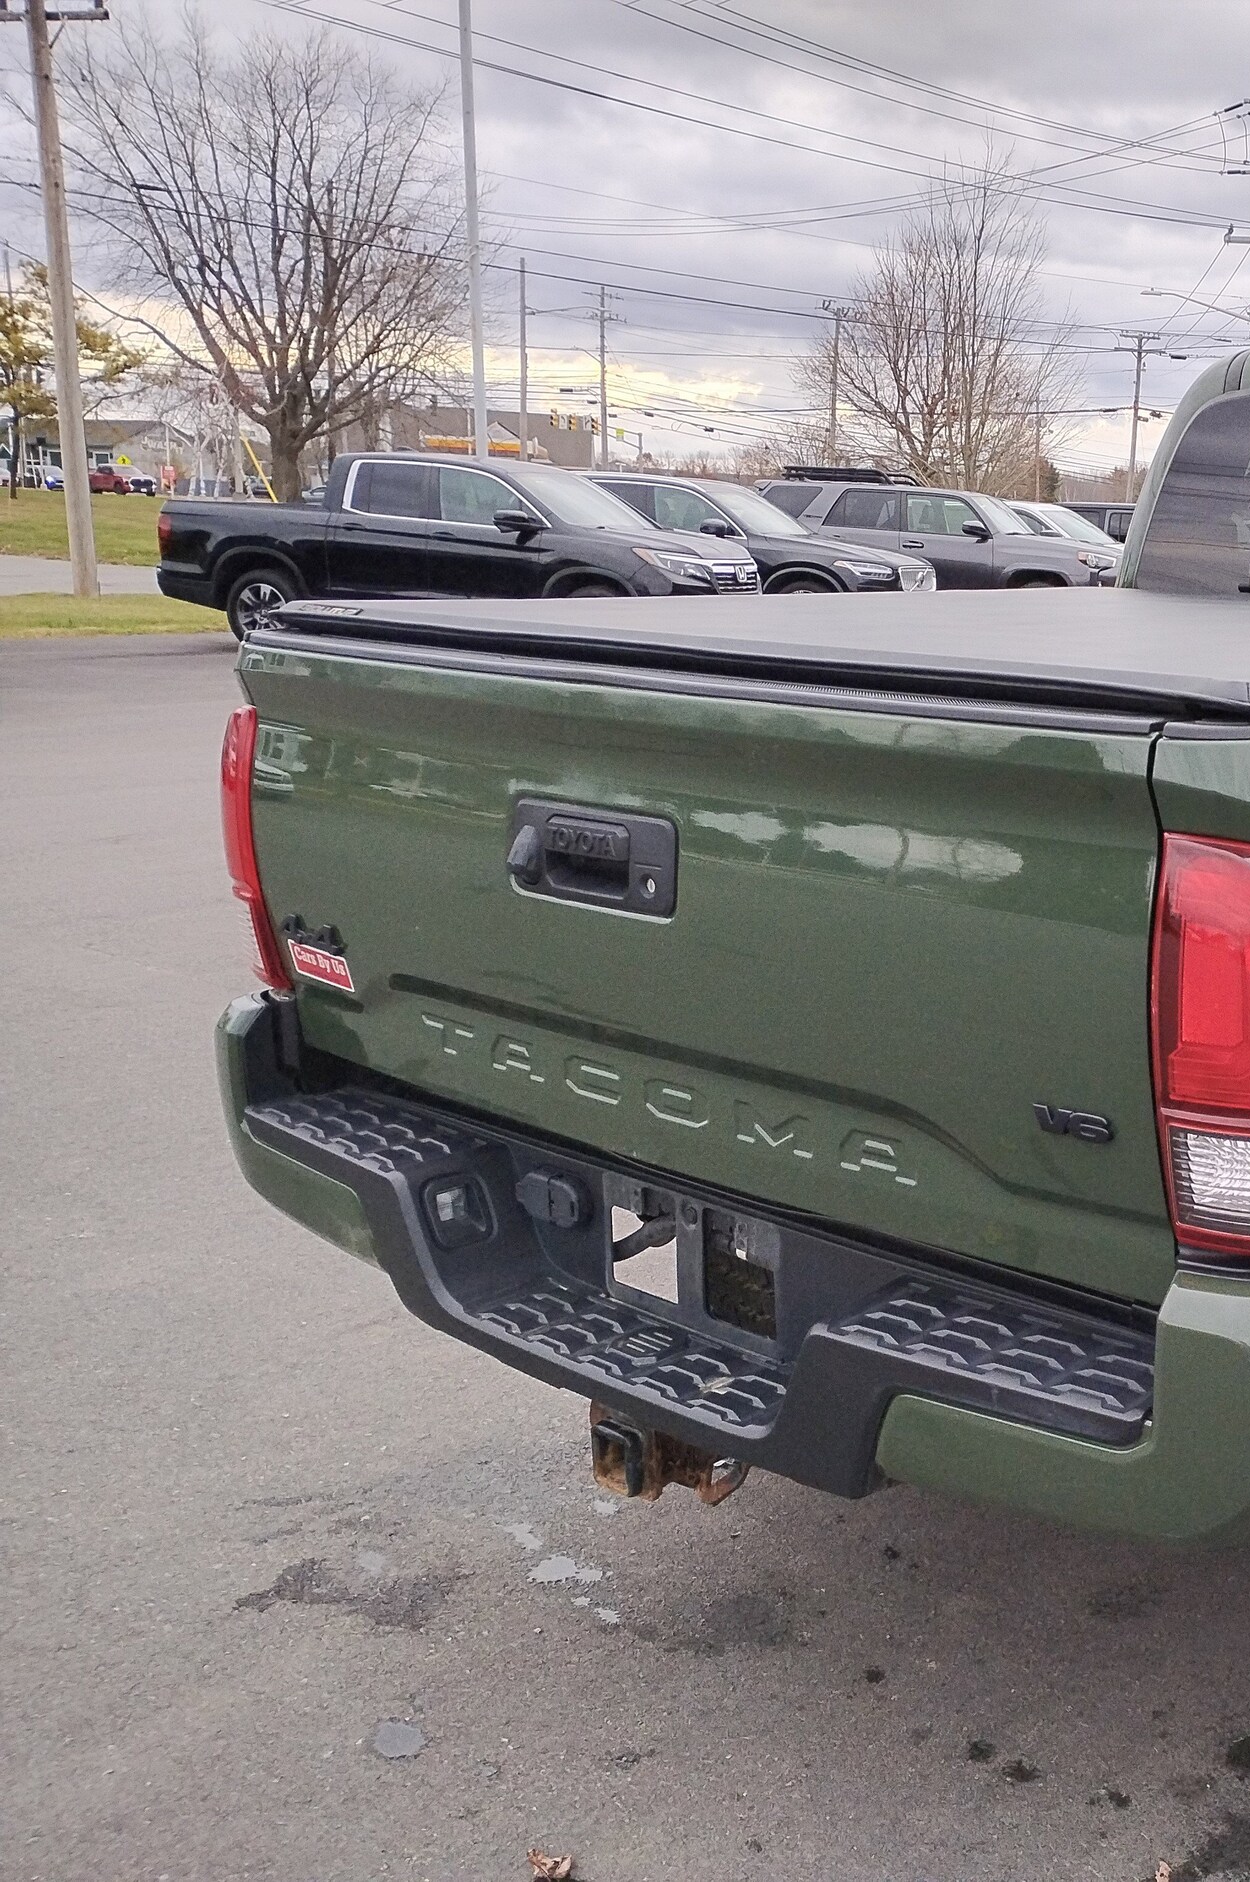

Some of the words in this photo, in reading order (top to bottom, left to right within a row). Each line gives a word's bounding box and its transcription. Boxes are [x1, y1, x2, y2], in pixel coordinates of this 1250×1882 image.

[550, 828, 617, 858] TOYOTA
[293, 945, 318, 966] Cars
[315, 953, 331, 974] By
[330, 958, 347, 976] Us
[421, 1010, 918, 1187] TACOMA
[1031, 1102, 1112, 1143] V6
